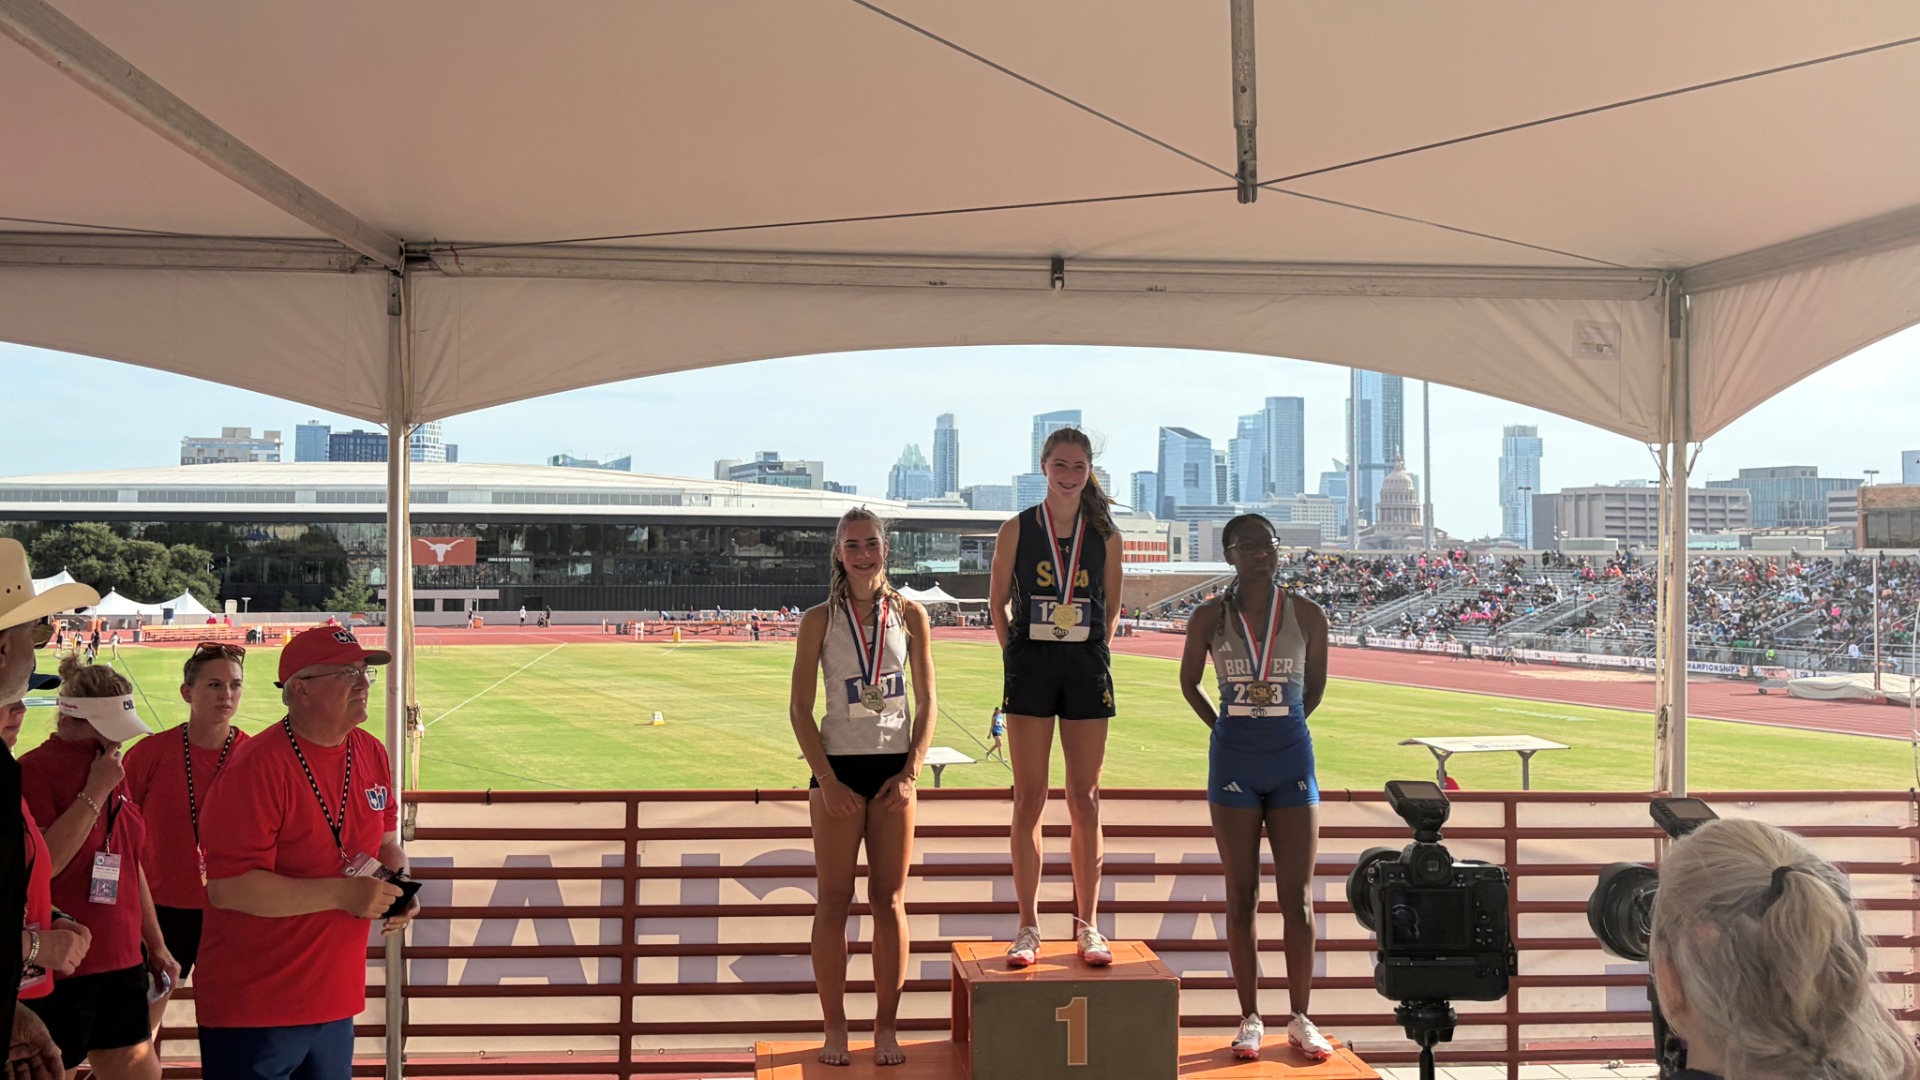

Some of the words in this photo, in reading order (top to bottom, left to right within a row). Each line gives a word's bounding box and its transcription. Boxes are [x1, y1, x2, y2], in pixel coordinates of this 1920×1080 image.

[1039, 601, 1083, 624] 125
[1225, 658, 1294, 675] BREER
[853, 674, 897, 699] 187
[1233, 683, 1283, 705] 223
[1056, 997, 1088, 1066] 1
